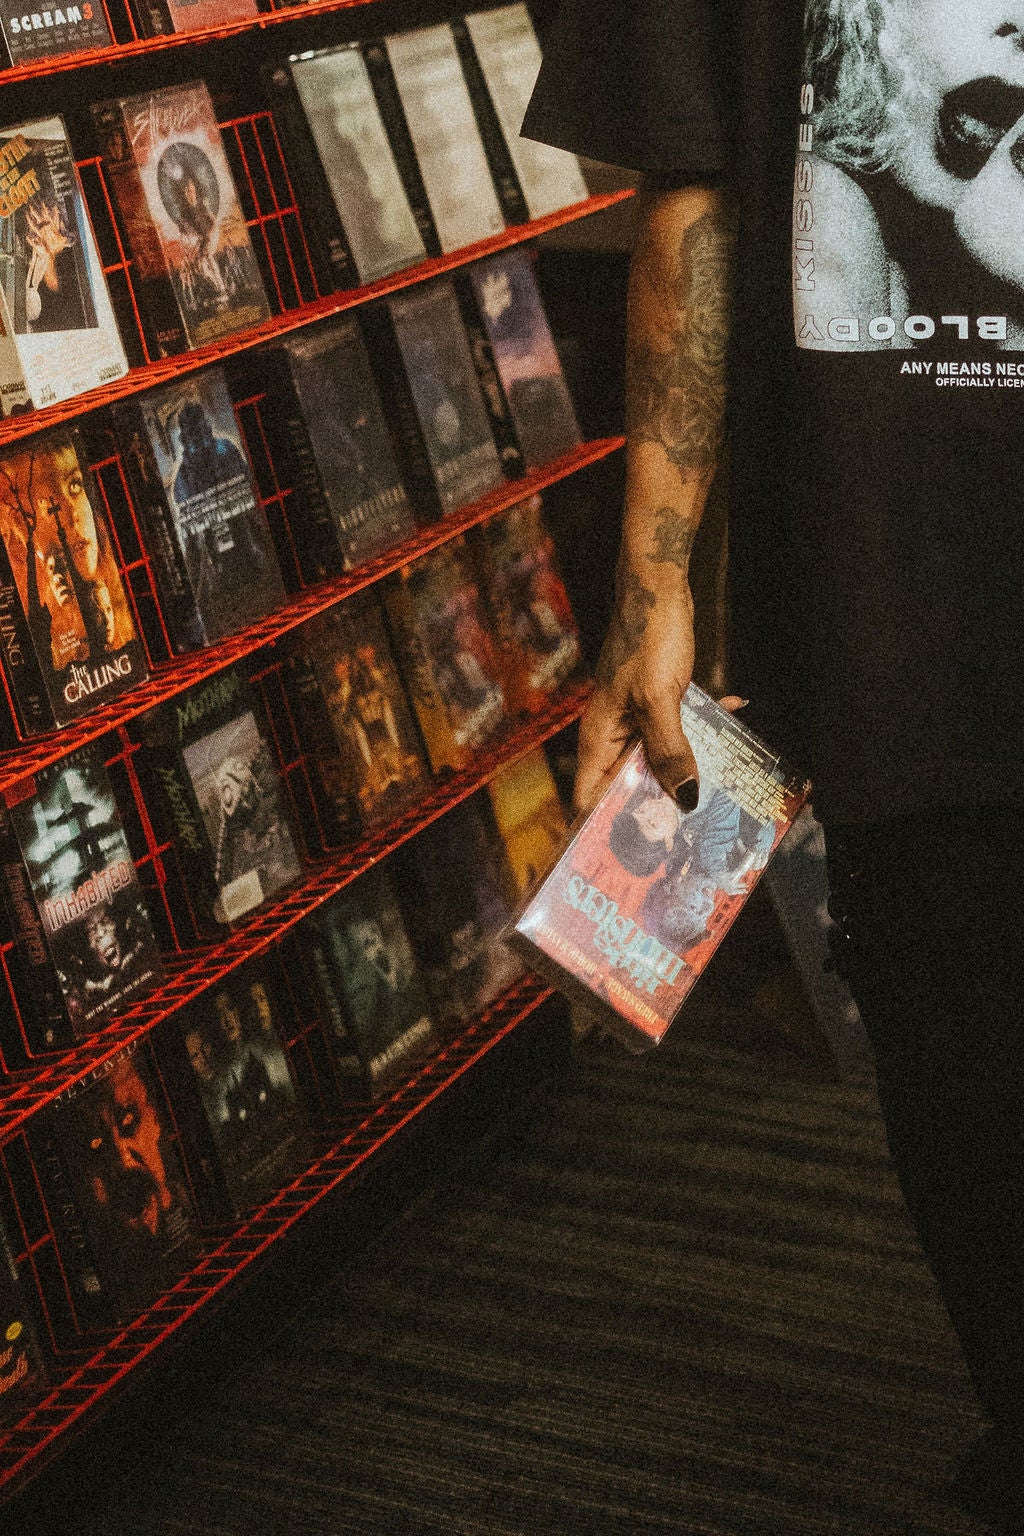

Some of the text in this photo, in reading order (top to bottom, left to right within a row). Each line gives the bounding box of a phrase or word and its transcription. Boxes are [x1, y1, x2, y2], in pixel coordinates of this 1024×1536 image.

[10, 3, 94, 34] SCREAM 3
[0, 168, 43, 219] CLOSET
[794, 83, 1008, 343] BLOODY KISSES
[900, 361, 933, 375] ANY
[936, 362, 992, 376] MEANS
[935, 376, 996, 389] OFFICIALLY
[63, 653, 132, 704] CALLING
[43, 862, 134, 932] INHABITED
[562, 875, 687, 986] monsters
[604, 976, 639, 1008] SAVAGE
